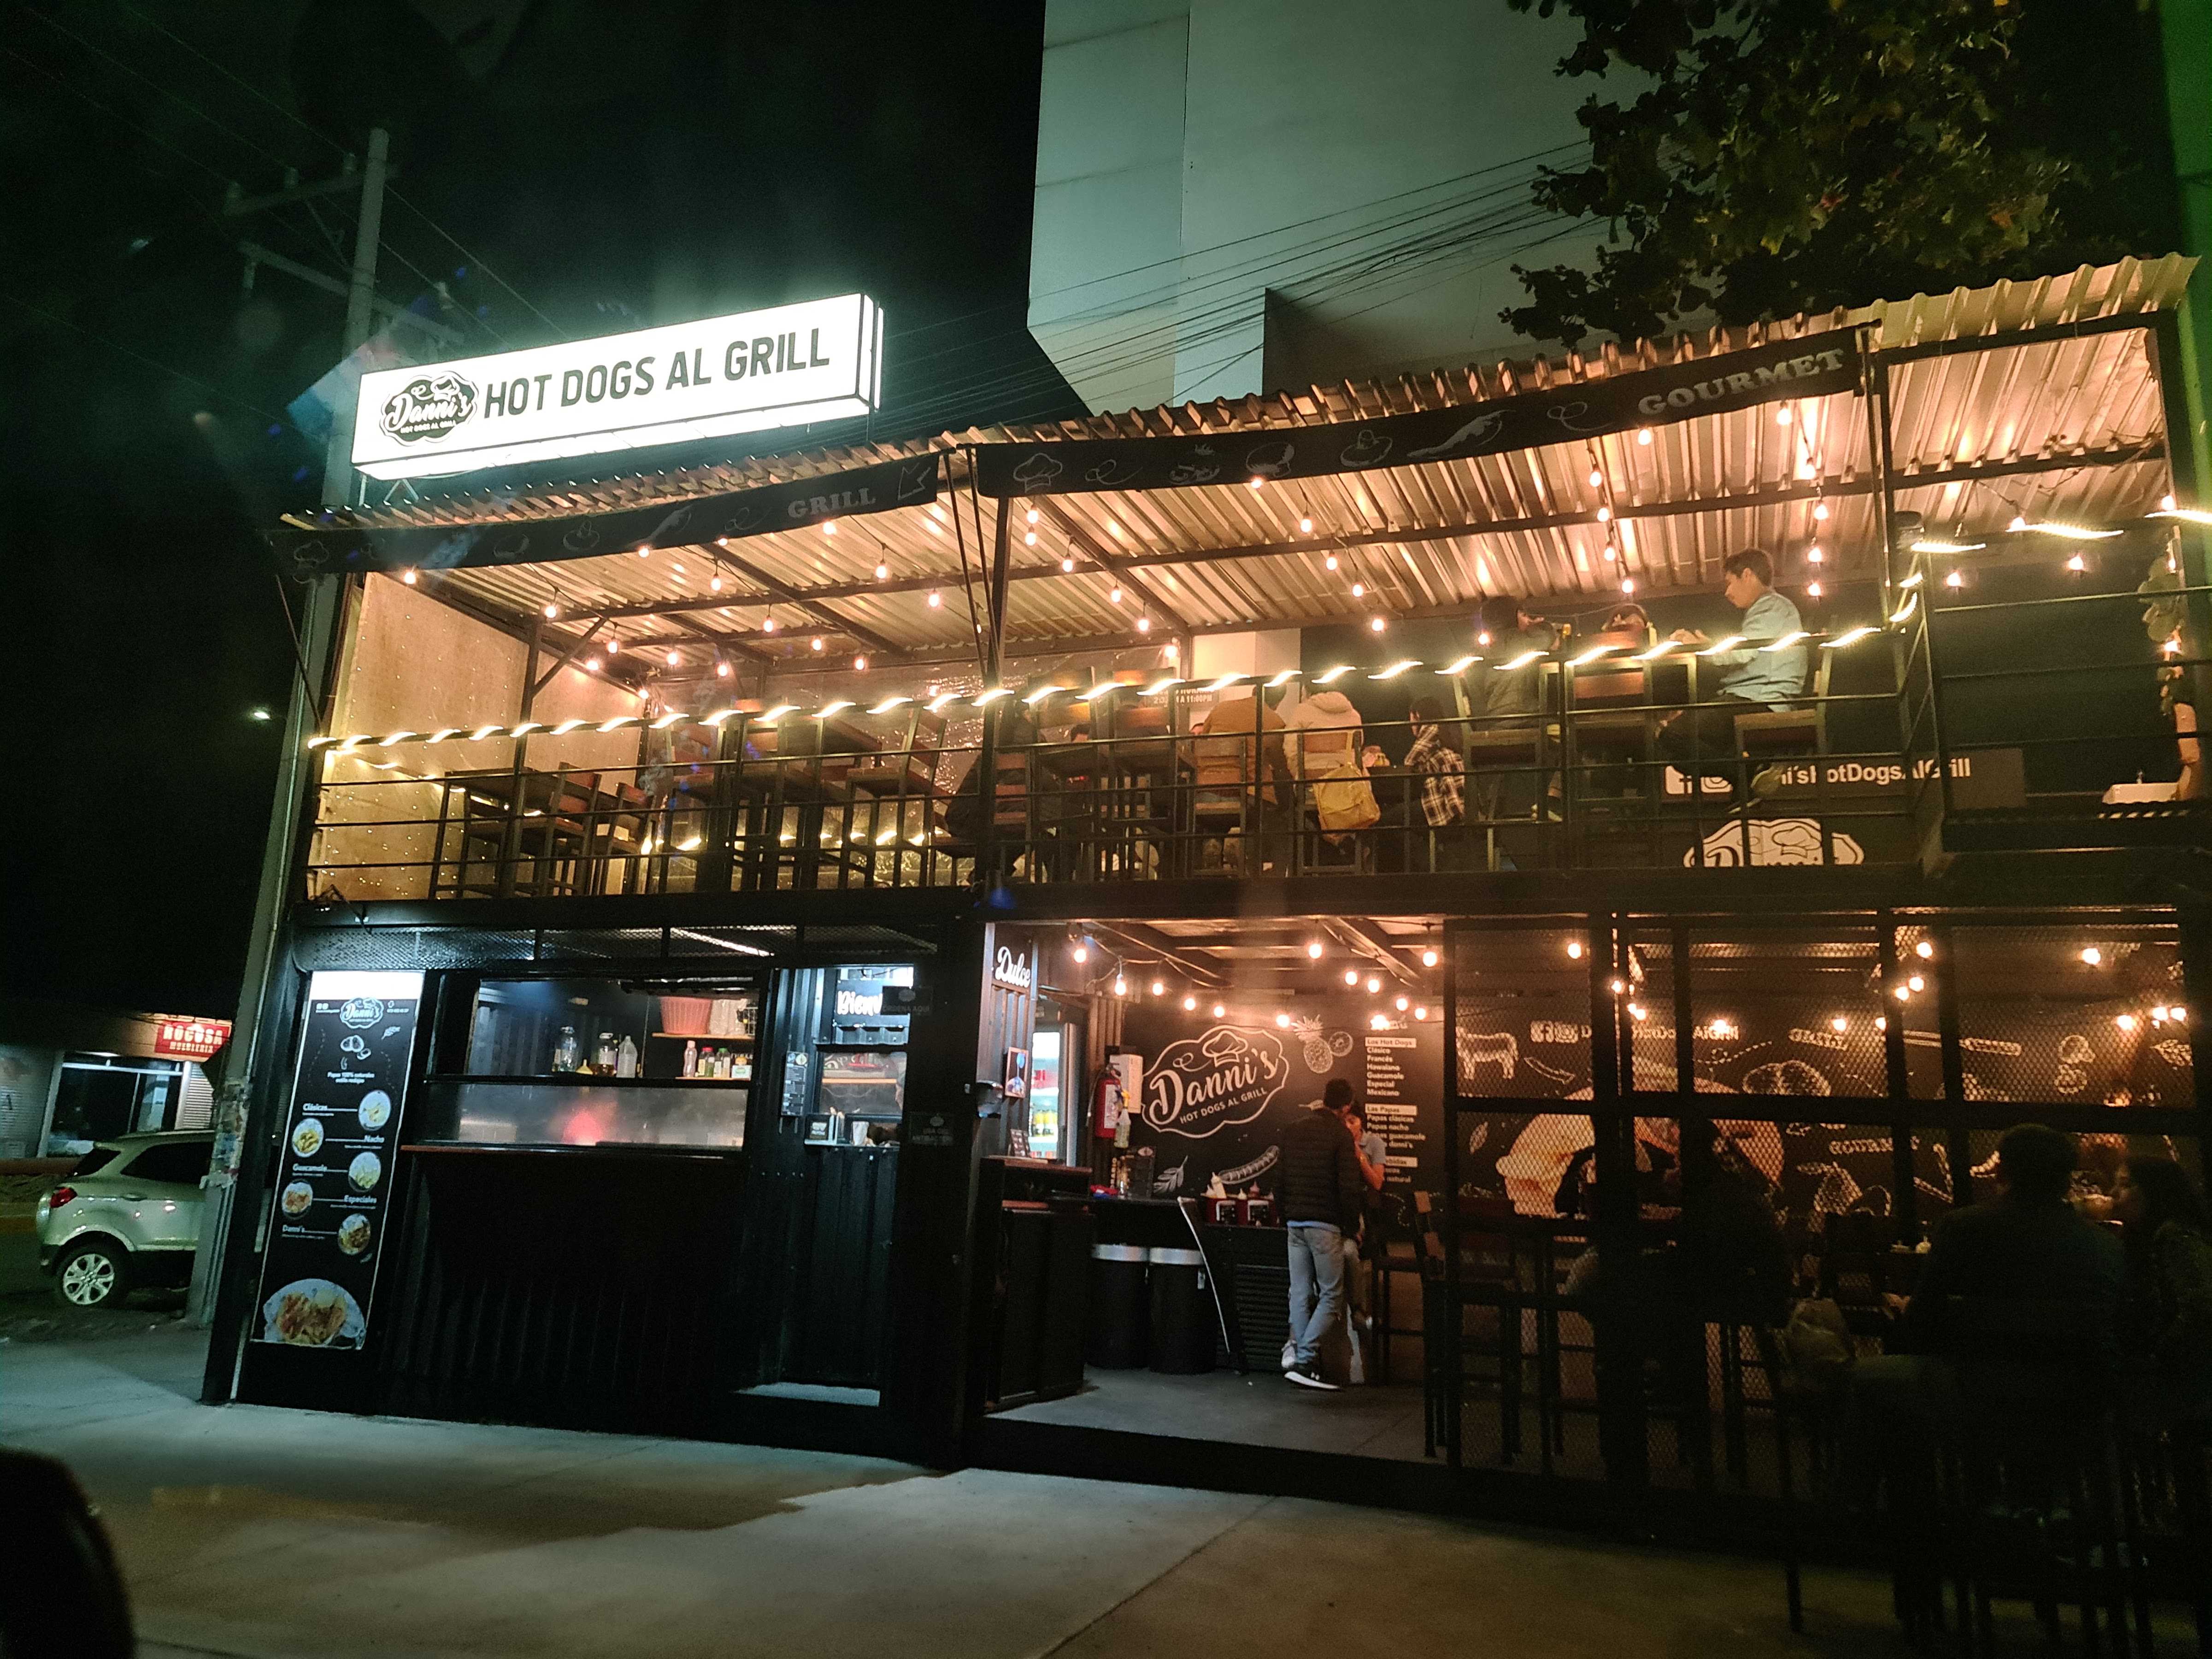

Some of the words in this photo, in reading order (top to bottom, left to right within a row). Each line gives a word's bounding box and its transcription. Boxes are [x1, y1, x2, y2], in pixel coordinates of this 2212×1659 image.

[484, 374, 552, 418] HOT
[561, 356, 656, 407] DOGS
[665, 348, 712, 390] AL
[724, 328, 830, 381] GRILL
[1638, 348, 1844, 415] GOURMET
[384, 393, 471, 431] Danni's
[787, 488, 876, 519] GRILL
[995, 946, 1030, 988] Dulce
[1149, 1048, 1279, 1125] Danni's
[1367, 1071, 1405, 1080] Guacamole
[1367, 1080, 1395, 1088] Especial
[1180, 1111, 1198, 1124] HOT
[1201, 1101, 1226, 1117] DOGS
[1228, 1097, 1239, 1107] AL
[1241, 1087, 1268, 1102] GRILL
